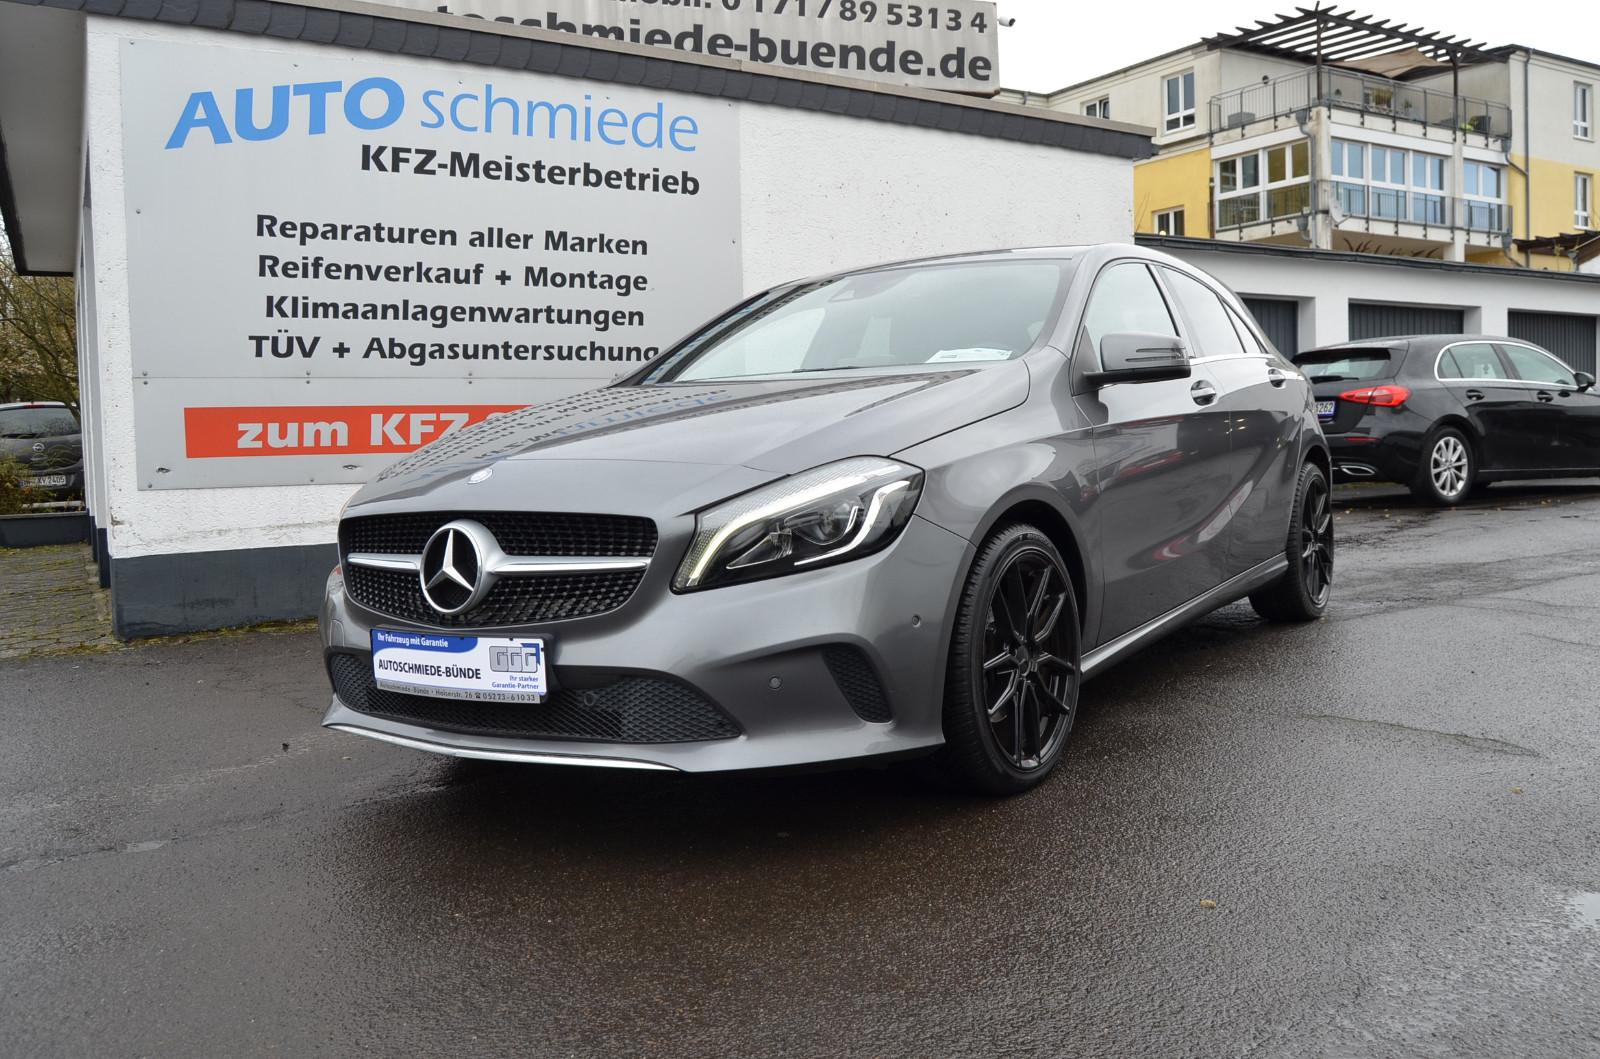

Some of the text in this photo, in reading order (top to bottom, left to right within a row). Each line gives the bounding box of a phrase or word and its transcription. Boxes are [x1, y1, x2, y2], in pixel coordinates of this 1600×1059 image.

[165, 77, 701, 153] AUTO schmiede
[361, 144, 700, 196] KFZ-Meisterbetrieb
[256, 214, 648, 256] Reparaturen aller Marken
[258, 254, 648, 294] Reifenverkauf + Montage
[265, 295, 645, 331] Klimaanlagenwartungen
[248, 329, 321, 359] TÜV
[332, 341, 351, 359] +
[237, 421, 348, 449] zum
[377, 632, 449, 648] Ihr Fahrzeug mit Garantie
[378, 658, 482, 680] AUTOSCHMIEDE-BÜNDE
[519, 675, 539, 683] starker
[491, 681, 539, 690] Garantie-Partner
